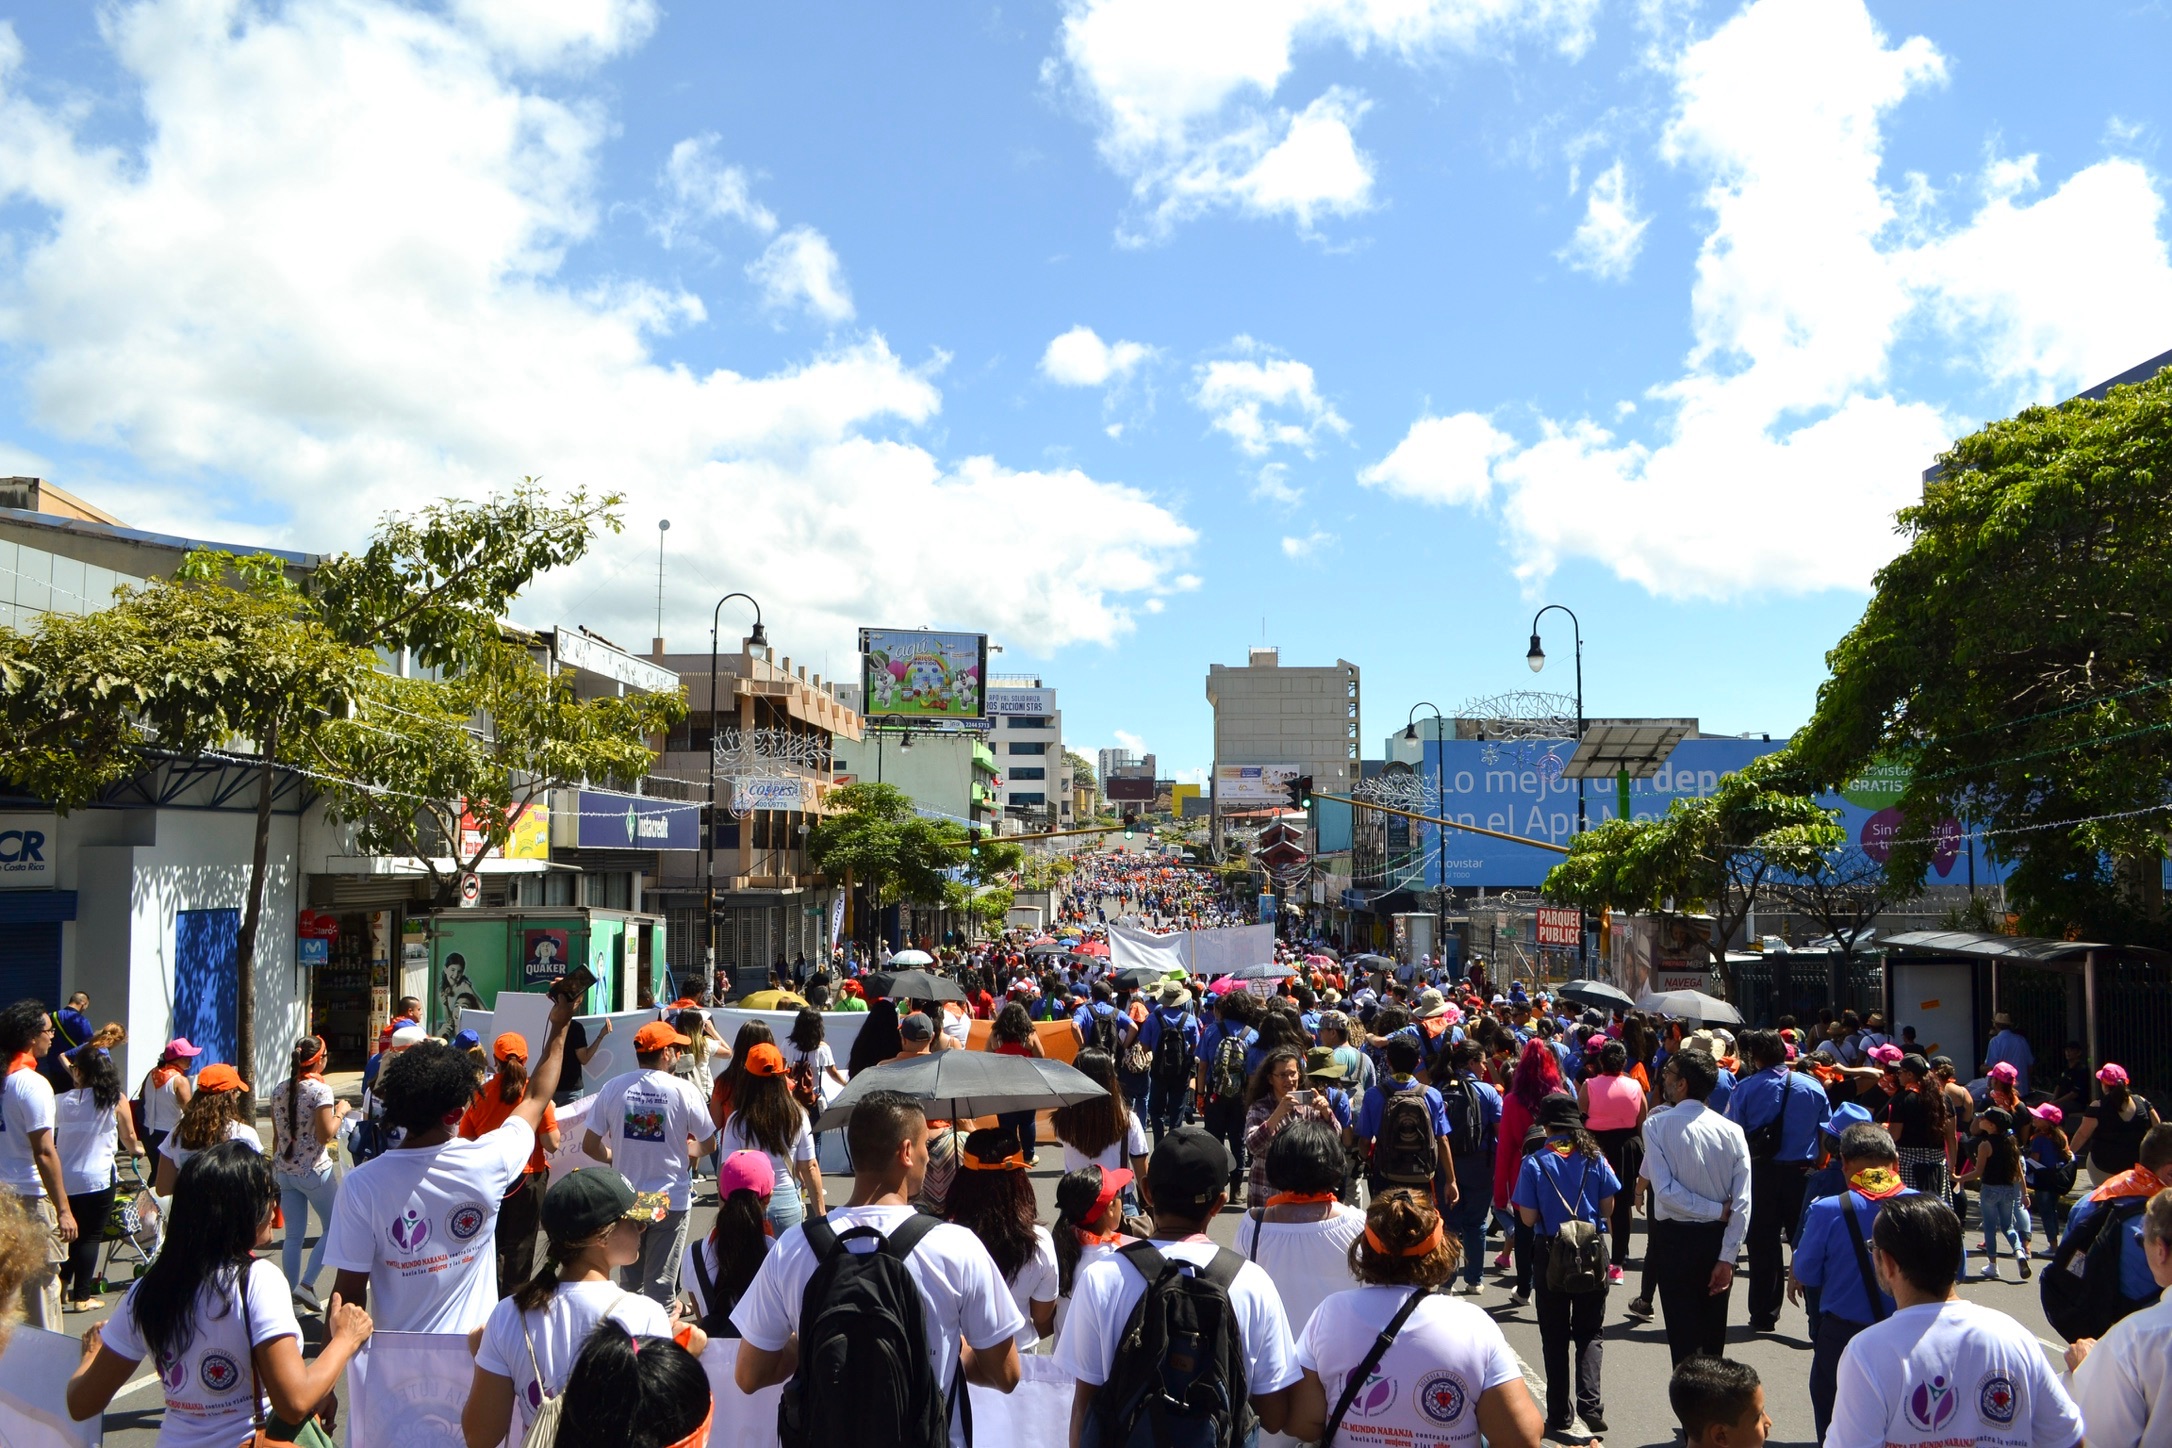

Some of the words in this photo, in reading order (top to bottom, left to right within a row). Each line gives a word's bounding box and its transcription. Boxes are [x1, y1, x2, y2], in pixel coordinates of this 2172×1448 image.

[896, 637, 928, 661] agú
[1436, 764, 1474, 794] Lo
[1850, 780, 1903, 792] GRATIS
[1487, 804, 1514, 835] el
[1872, 824, 1892, 836] Sin
[4, 863, 26, 871] Costa
[28, 863, 45, 871] Rica
[526, 963, 566, 975] QUAKER
[1664, 976, 1703, 988] NAVEGÁ
[422, 1253, 448, 1265] NARANJA
[1349, 1423, 1377, 1434] MUNDO
[1377, 1426, 1414, 1438] NARANJA
[1415, 1432, 1441, 1440] contra
[1350, 1434, 1370, 1443] hacia
[1384, 1438, 1412, 1448] mujeres
